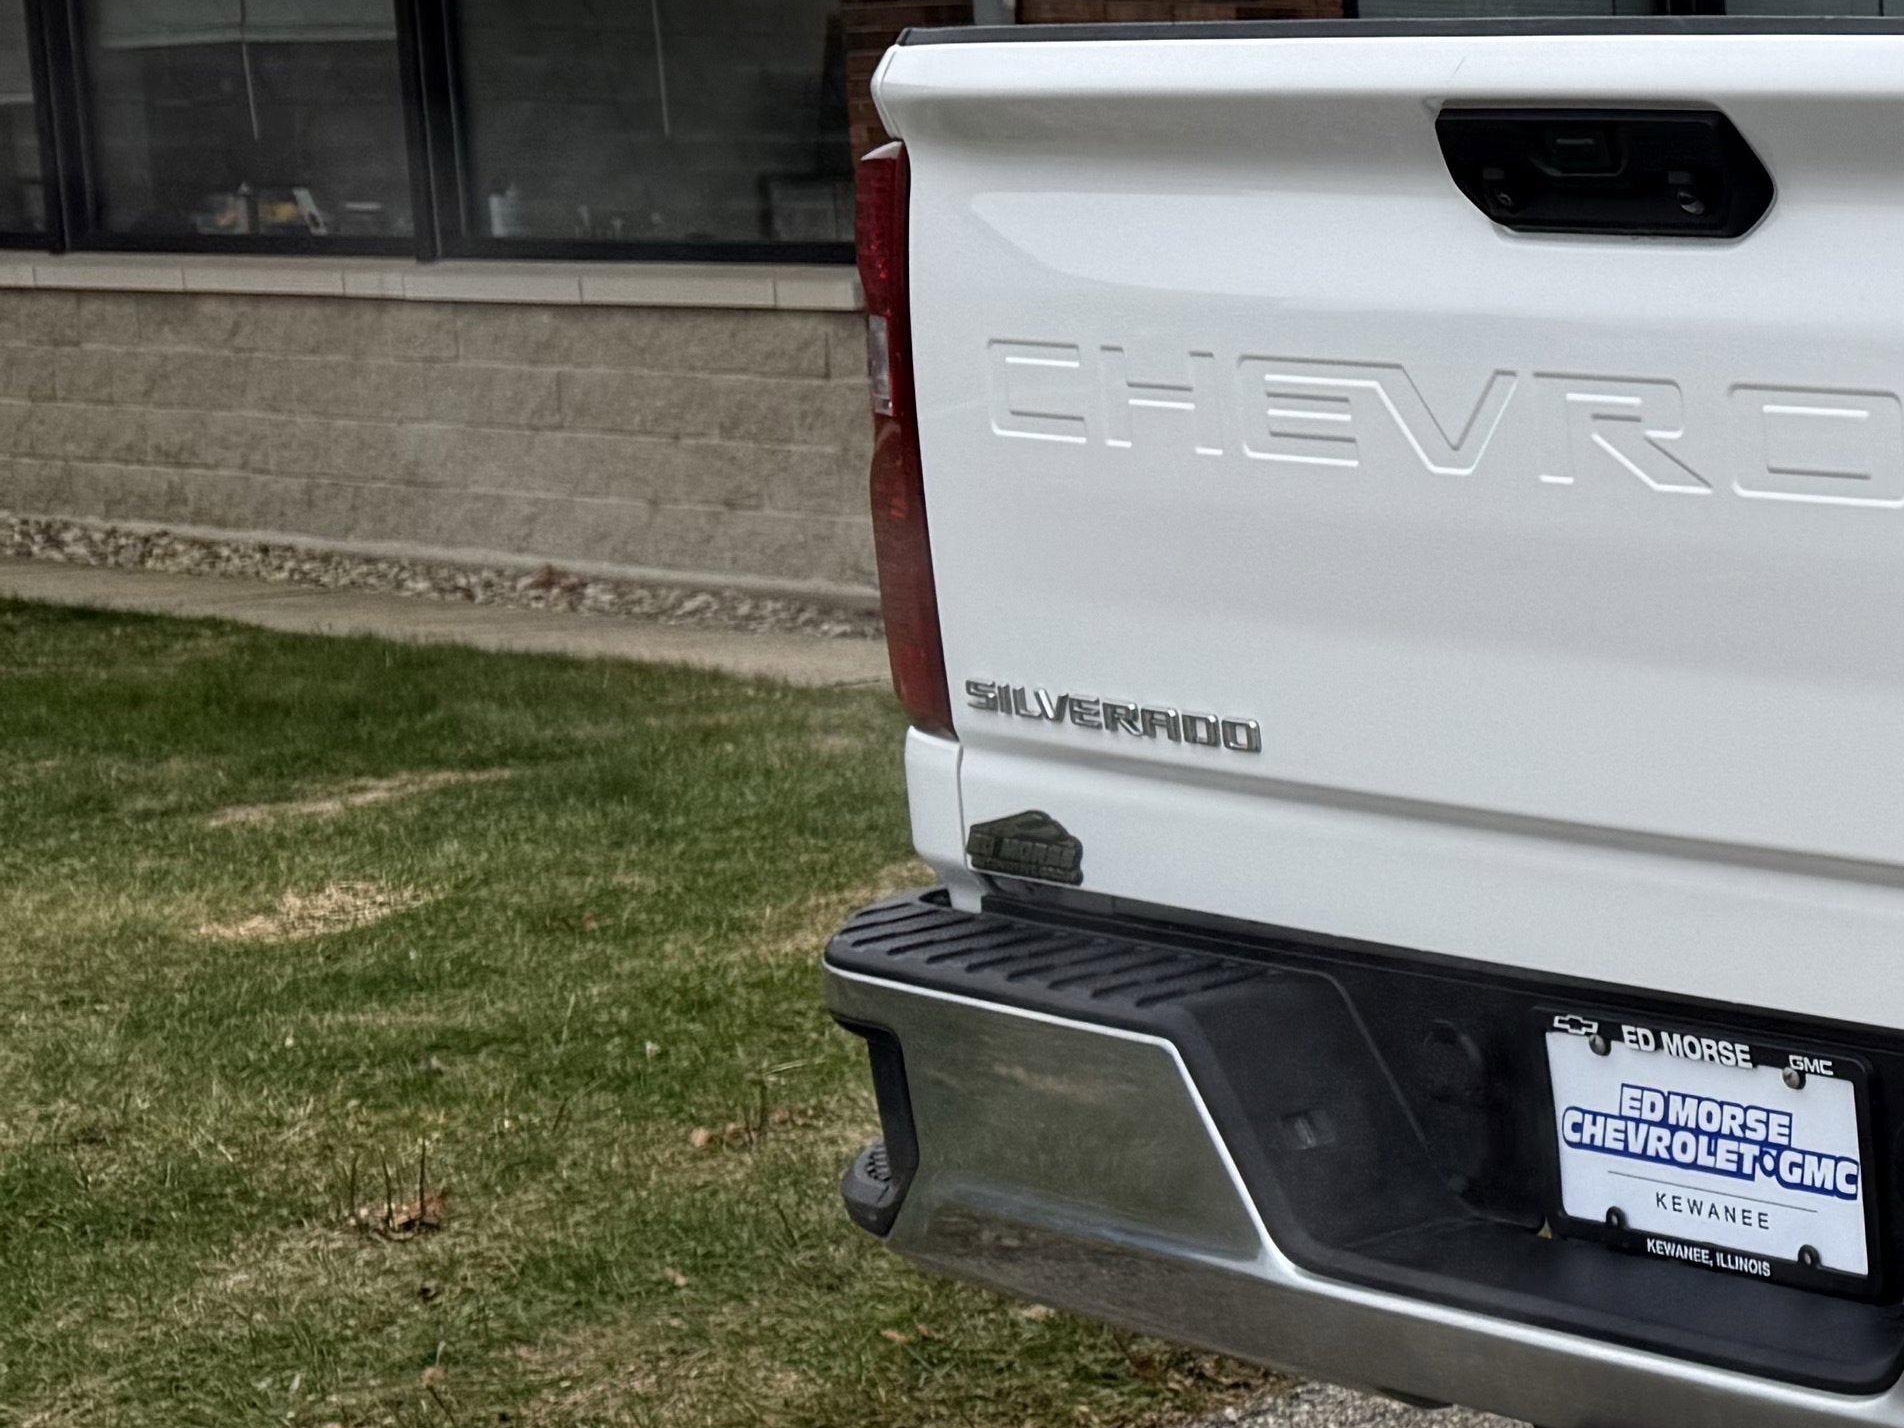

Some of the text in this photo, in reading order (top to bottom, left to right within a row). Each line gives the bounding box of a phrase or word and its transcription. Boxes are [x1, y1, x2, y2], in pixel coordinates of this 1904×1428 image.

[965, 678, 1263, 753] SILVERADO
[1621, 1025, 1754, 1069] ED MORSE
[1789, 1055, 1834, 1076] GMC
[1620, 1083, 1792, 1146] ED MORSE
[1655, 1191, 1770, 1230] KEWANEE
[1647, 1238, 1771, 1277] KEWANEE, ILLINOIS
